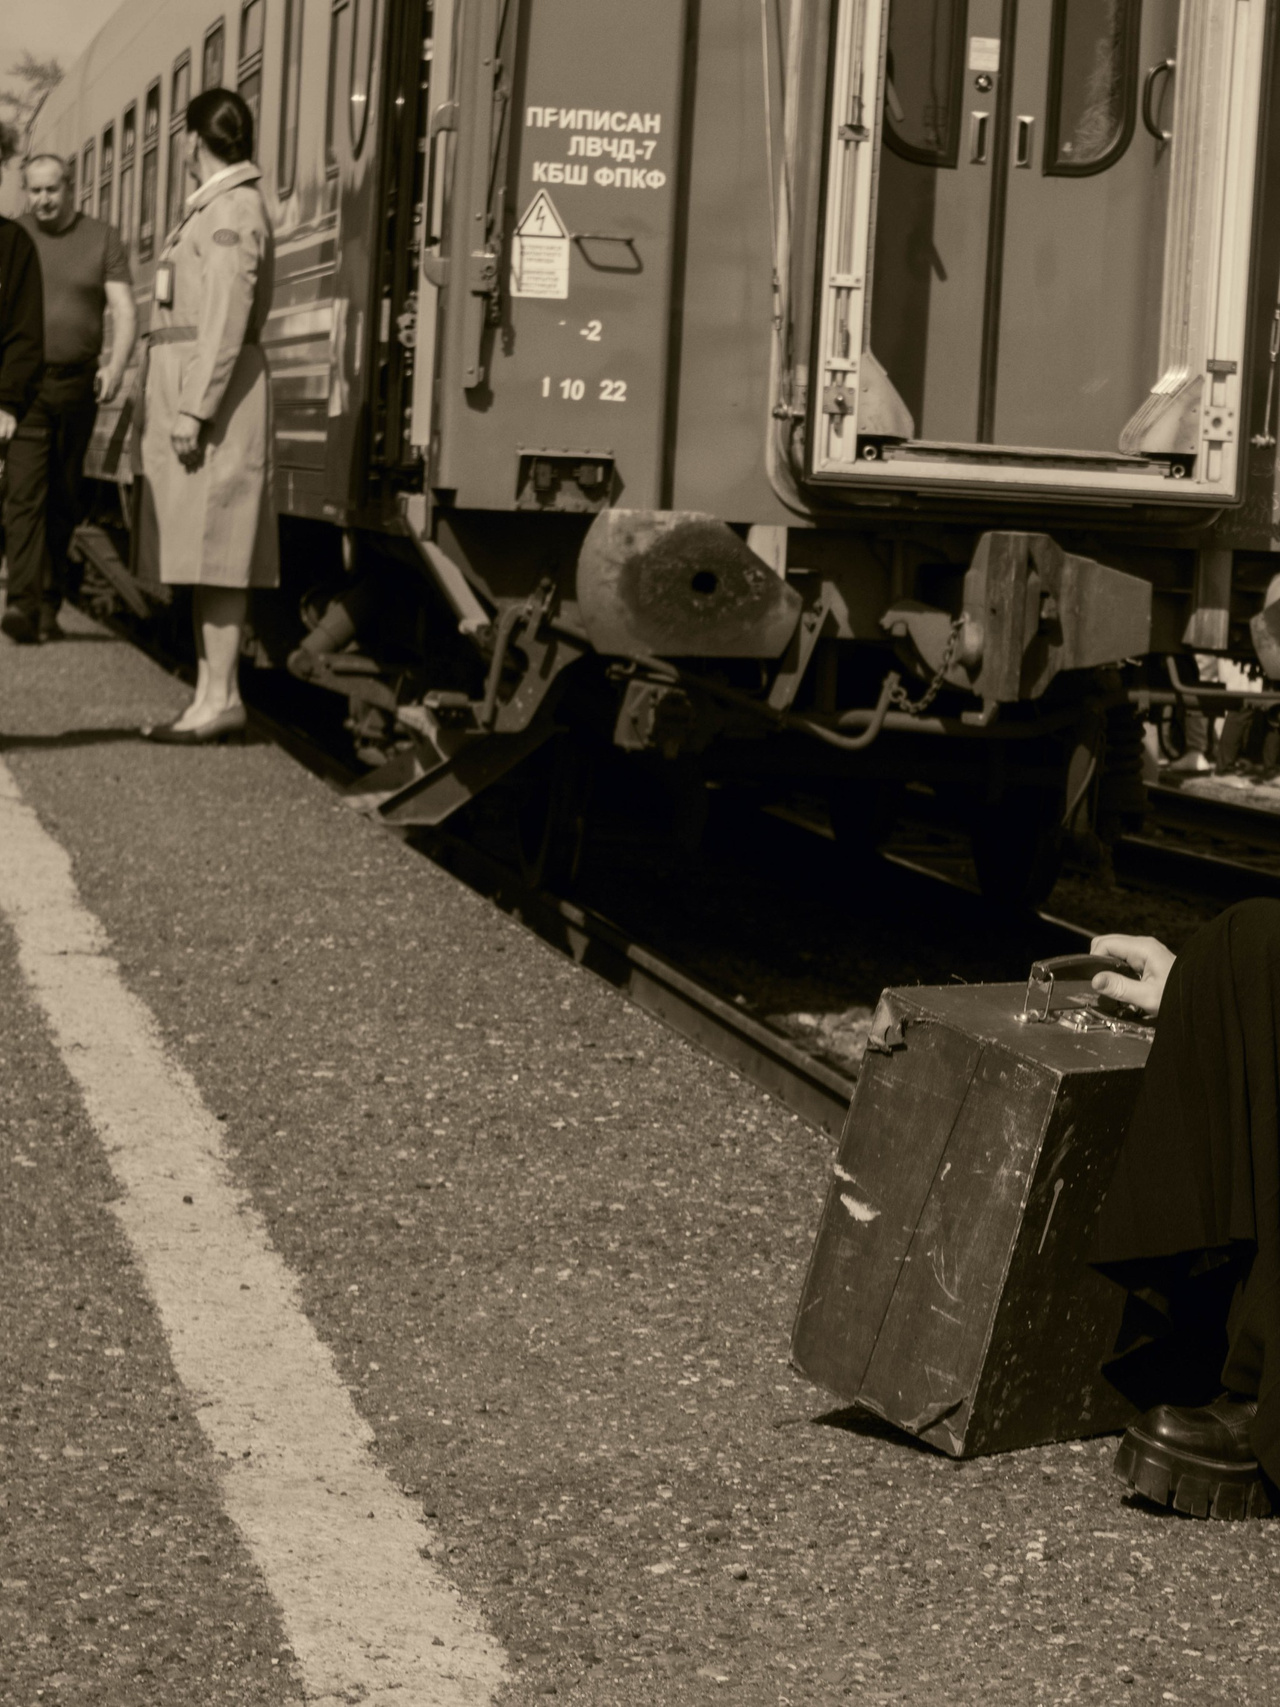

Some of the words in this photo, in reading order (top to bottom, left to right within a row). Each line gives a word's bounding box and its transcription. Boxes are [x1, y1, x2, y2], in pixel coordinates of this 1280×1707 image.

[526, 106, 661, 134] ПРИПИСАН
[567, 135, 657, 163] ЛВЧД-7
[532, 161, 588, 186] КБШ
[593, 166, 667, 189] ФПКФ
[560, 378, 585, 401] 10
[599, 378, 627, 402] 22
